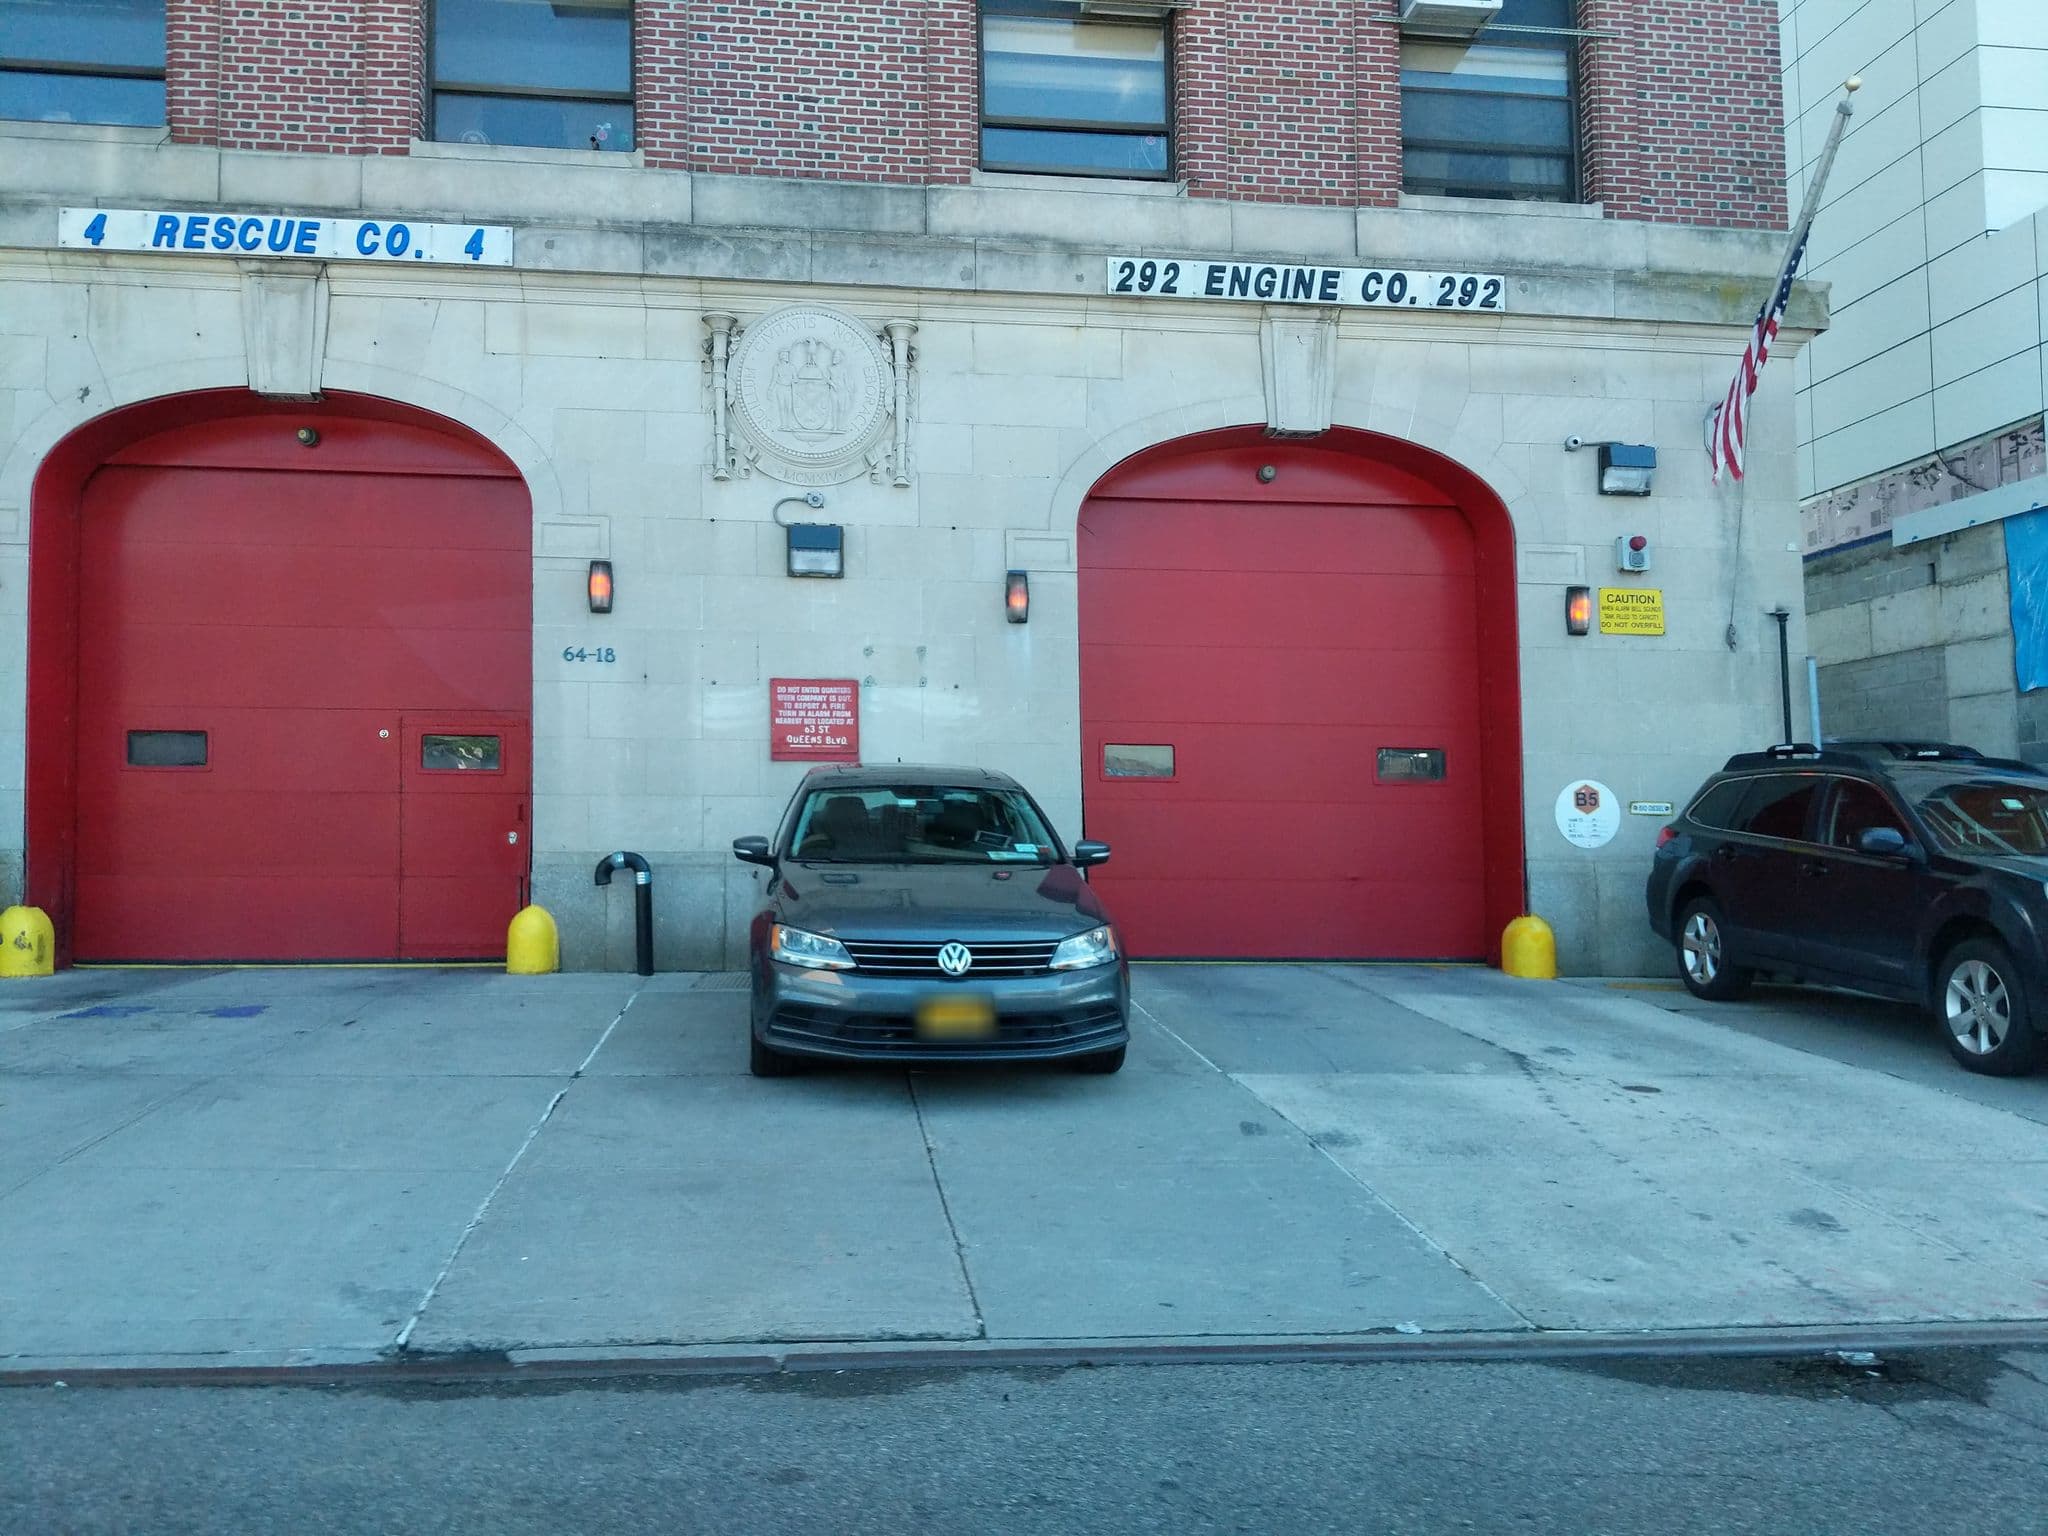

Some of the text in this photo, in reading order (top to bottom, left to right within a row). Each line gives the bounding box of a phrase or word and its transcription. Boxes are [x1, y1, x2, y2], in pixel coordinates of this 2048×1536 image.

[84, 213, 484, 260] 4 RESCUE CO. 4
[1115, 260, 1501, 309] 292 ENGINE CO. 292
[1606, 593, 1655, 604] CAUTION
[563, 646, 616, 663] 64-18
[777, 686, 787, 694] DO
[787, 686, 800, 694] NOT
[801, 686, 820, 694] ENTER
[777, 694, 796, 702] WHEN
[796, 694, 828, 702] COMPANY
[807, 710, 831, 718] ALARM
[832, 710, 852, 718] FROM
[817, 718, 845, 726] LOCATED
[846, 718, 854, 726] AT
[804, 725, 816, 734] 63
[786, 735, 823, 744] QUEENS
[1575, 792, 1598, 807] B5
